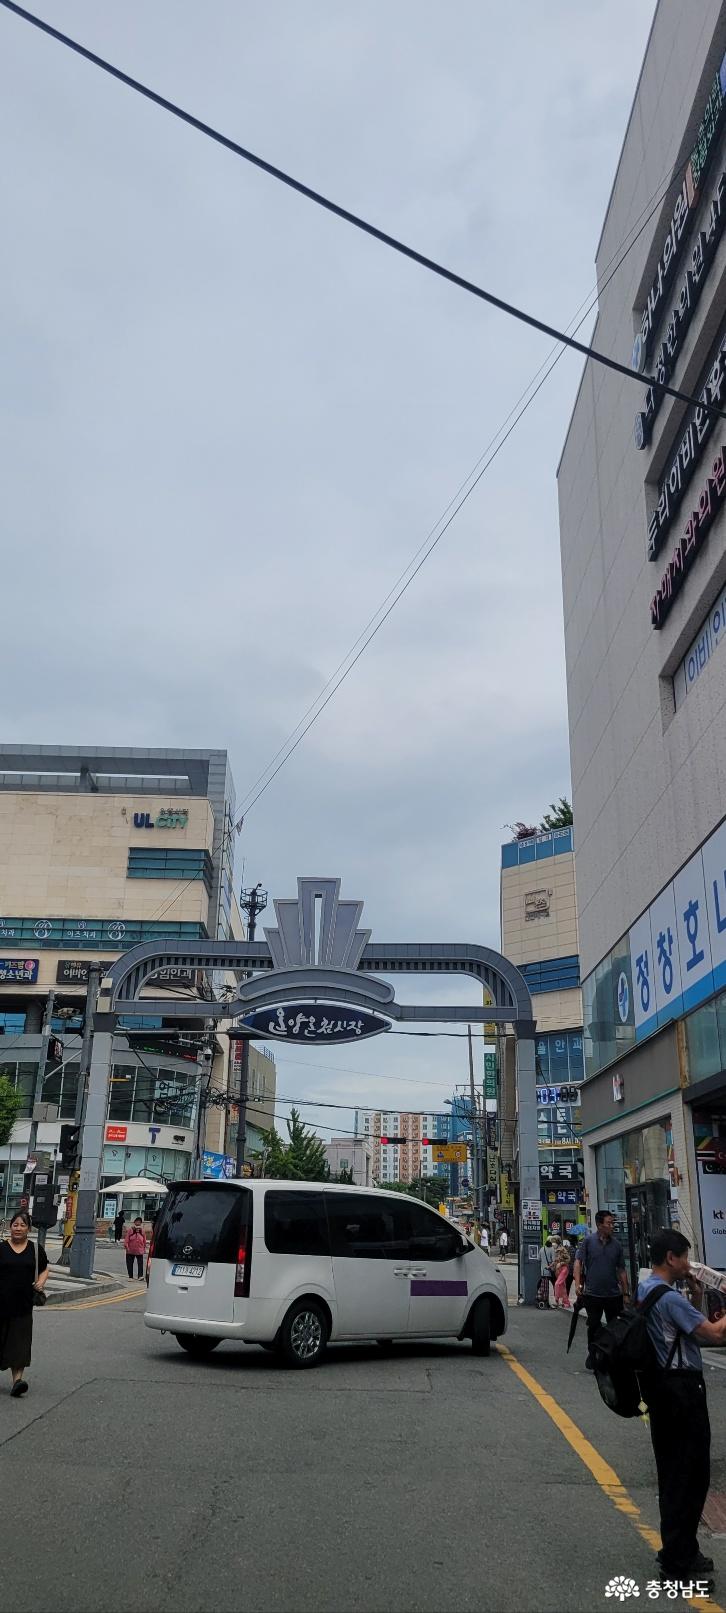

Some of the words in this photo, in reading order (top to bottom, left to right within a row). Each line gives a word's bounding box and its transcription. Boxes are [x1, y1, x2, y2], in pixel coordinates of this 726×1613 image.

[641, 180, 689, 344] 하나의원
[134, 813, 154, 828] UL
[541, 1165, 573, 1179] 약국
[713, 1210, 725, 1220] kt
